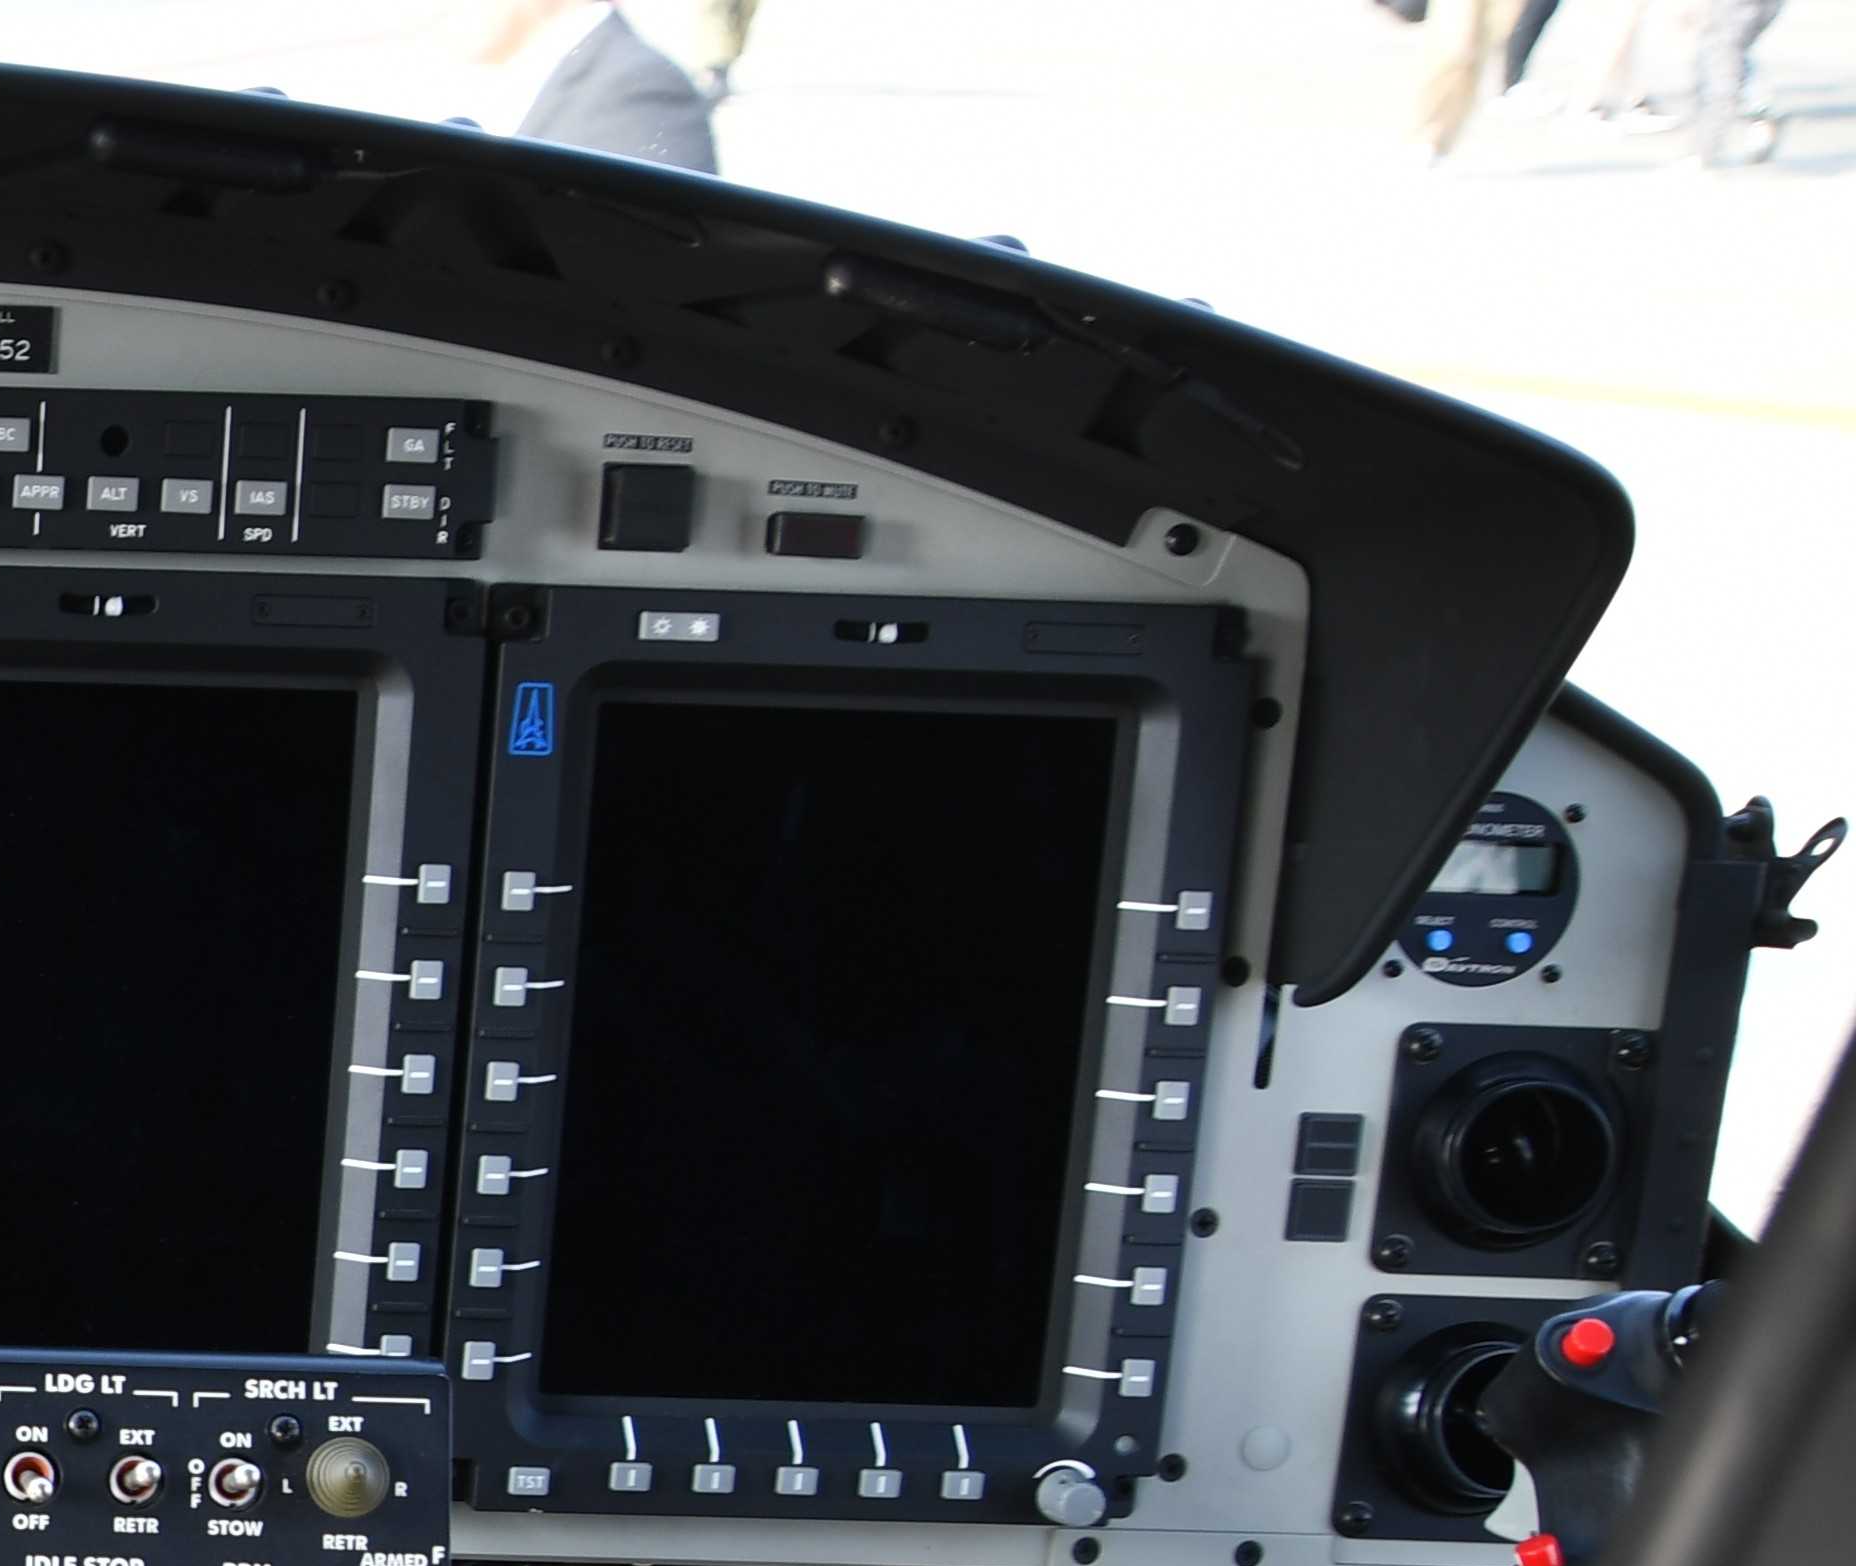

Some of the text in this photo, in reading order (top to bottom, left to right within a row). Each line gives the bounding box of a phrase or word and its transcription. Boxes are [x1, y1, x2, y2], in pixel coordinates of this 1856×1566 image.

[405, 439, 424, 453] GA
[21, 484, 59, 499] APPR
[391, 494, 429, 510] STBY
[110, 524, 146, 539] VERT
[244, 527, 272, 543] SPD
[45, 1373, 126, 1394] LDG LT
[245, 1379, 338, 1401] SRCH LT
[328, 1417, 363, 1432] EXT
[16, 1426, 48, 1442] ON
[120, 1430, 155, 1446] EXT
[220, 1432, 251, 1448] ON
[12, 1515, 50, 1531] OFF
[114, 1518, 159, 1534] RETR
[207, 1520, 262, 1537] STOW
[322, 1534, 368, 1551] RETR
